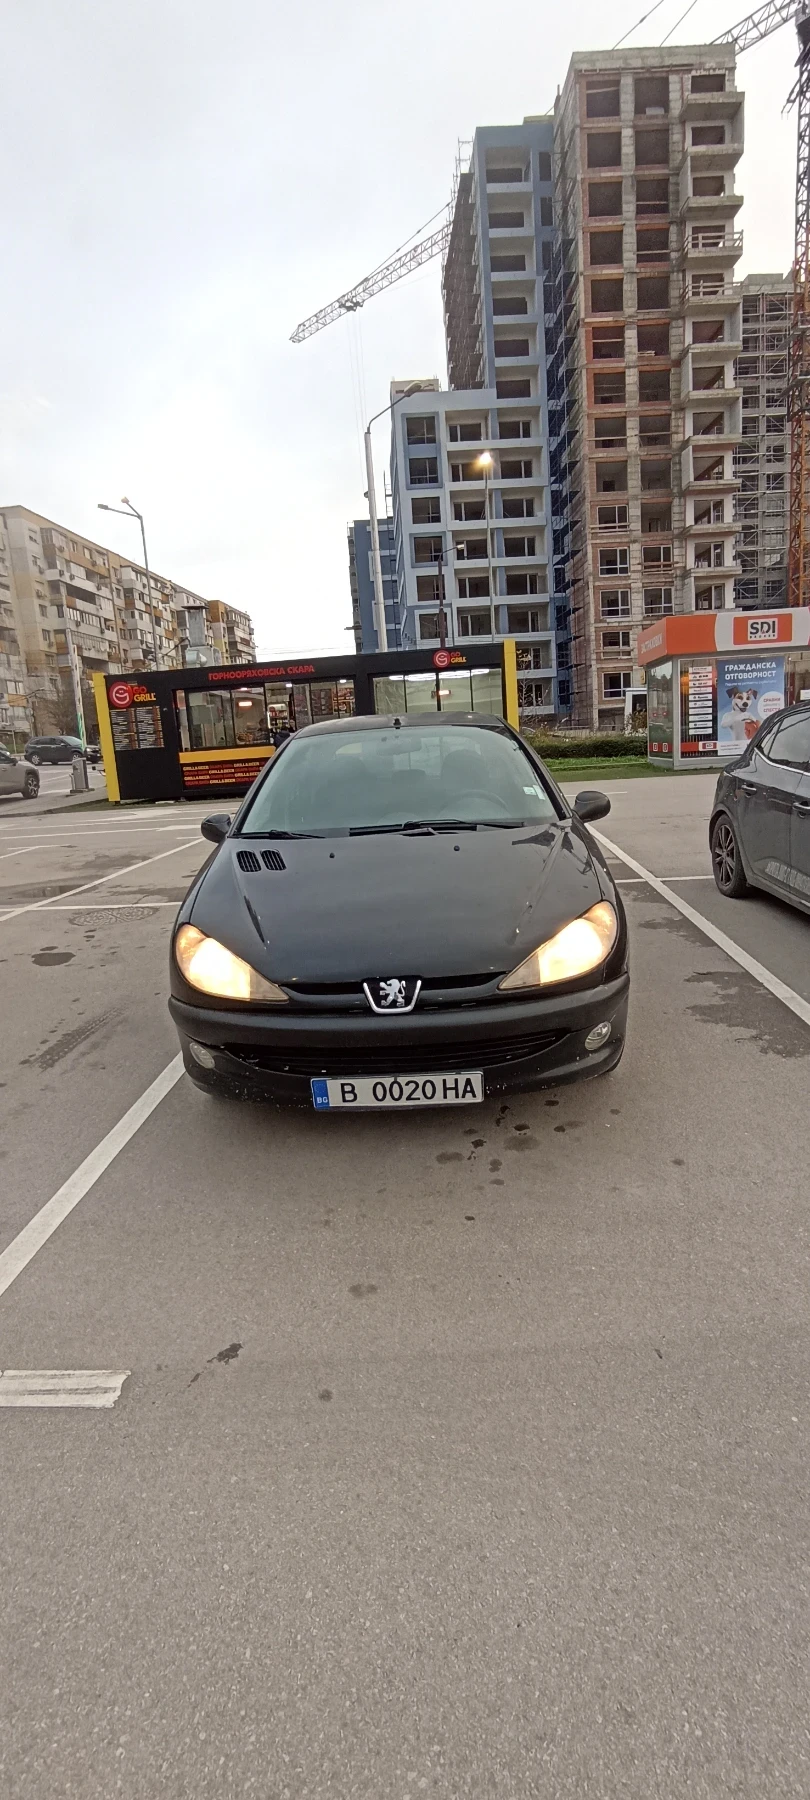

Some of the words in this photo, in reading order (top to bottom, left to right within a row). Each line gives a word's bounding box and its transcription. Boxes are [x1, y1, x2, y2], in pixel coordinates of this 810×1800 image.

[750, 620, 776, 635] SDI
[725, 661, 777, 671] ГРАЖДАНСКА
[208, 667, 285, 681] ГОРНООРЯХОВСКА
[287, 664, 315, 675] СКАРА
[725, 670, 777, 680] ОТГОВОРНОСТ
[133, 686, 147, 694] GO
[133, 692, 156, 702] GRILL
[340, 1082, 358, 1103] B
[372, 1080, 437, 1102] 0020
[442, 1078, 477, 1099] HA
[316, 1096, 328, 1104] BG
